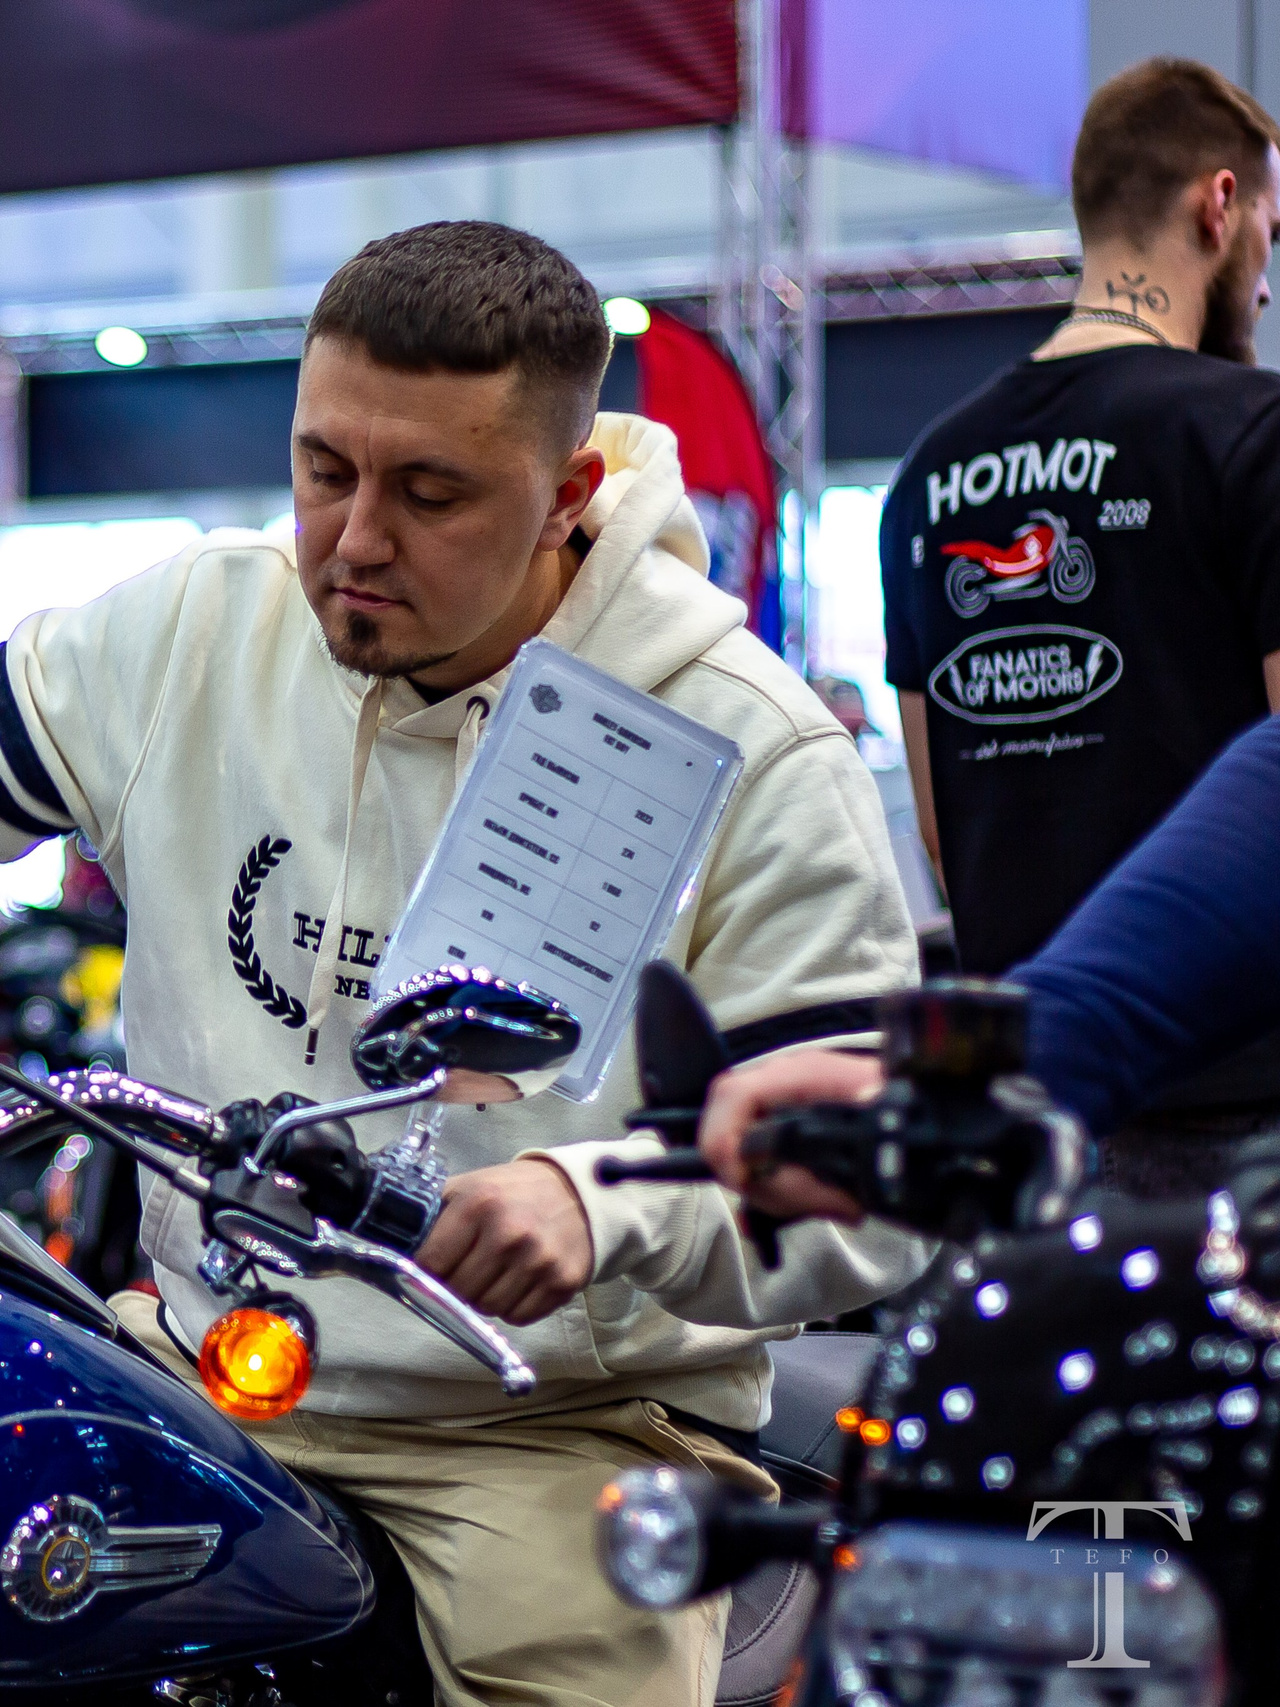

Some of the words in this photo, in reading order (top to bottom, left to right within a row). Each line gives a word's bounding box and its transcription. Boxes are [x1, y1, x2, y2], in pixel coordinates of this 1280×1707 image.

[927, 438, 1117, 525] HOTMOT
[965, 679, 991, 706] OF
[993, 665, 1084, 703] MOTORS
[970, 644, 1072, 681] FANATICS
[293, 911, 391, 968] HIL
